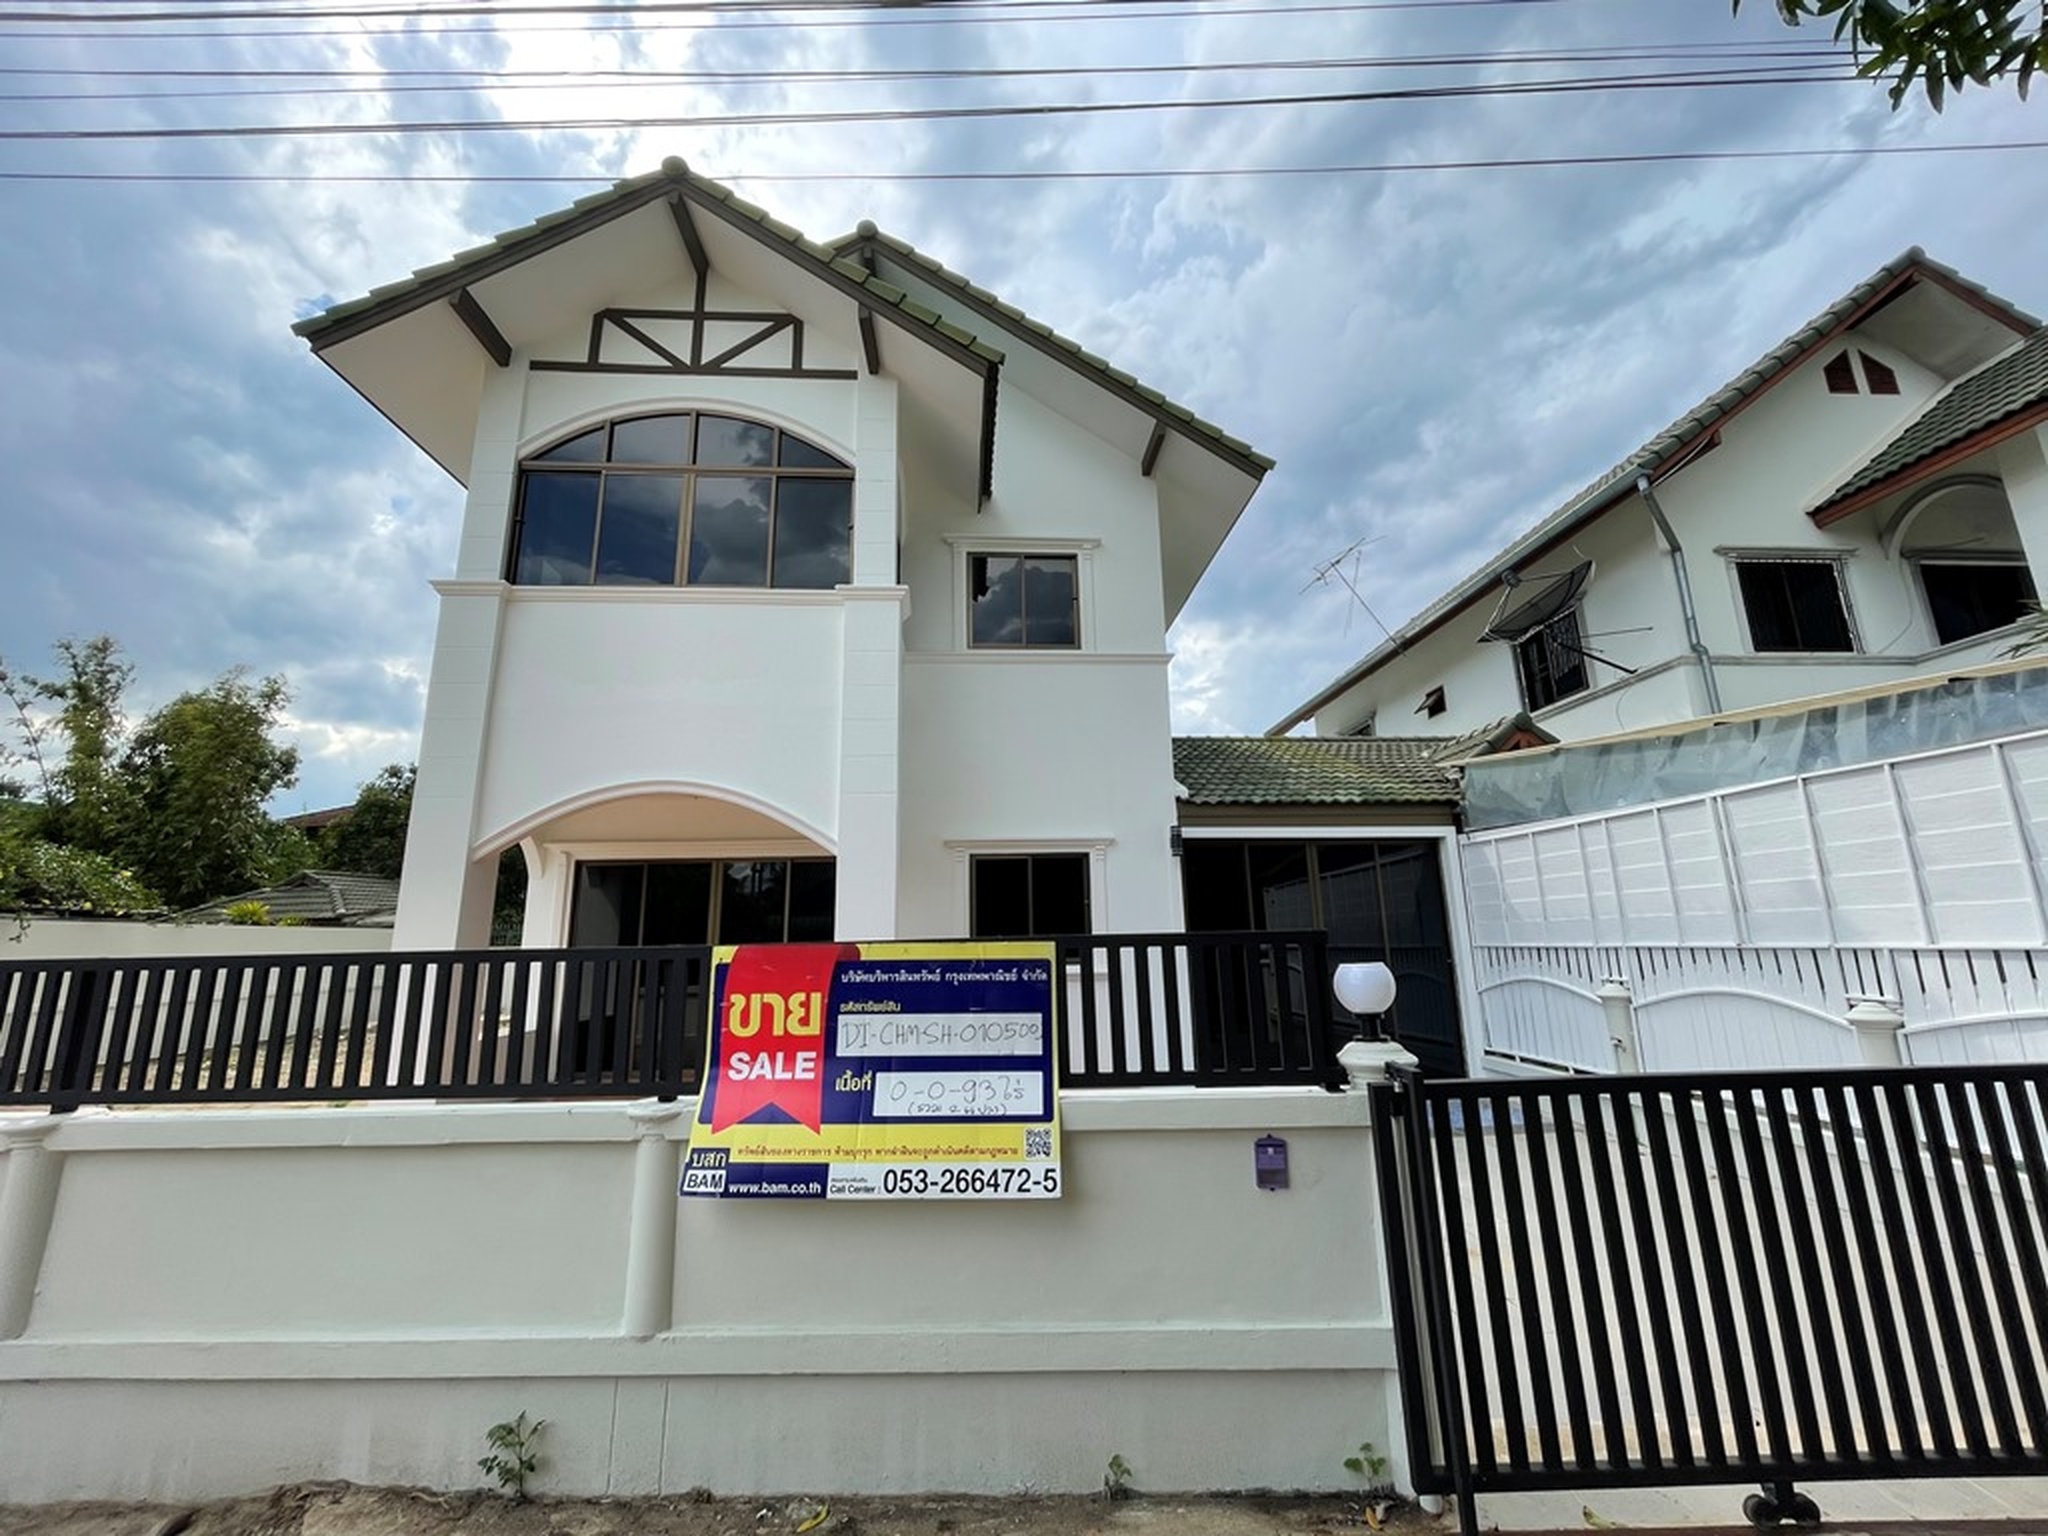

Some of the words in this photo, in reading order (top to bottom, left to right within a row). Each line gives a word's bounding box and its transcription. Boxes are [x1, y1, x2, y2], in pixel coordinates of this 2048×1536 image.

[728, 991, 821, 1037] ขาย
[728, 1051, 817, 1081] SALE
[835, 1069, 873, 1092] เนื้อที่
[686, 1173, 724, 1189] BAM
[728, 1182, 822, 1195] www.bam.co.th
[830, 1184, 846, 1194] Call
[848, 1184, 876, 1194] Center
[883, 1168, 1058, 1194] 053-266472-5
